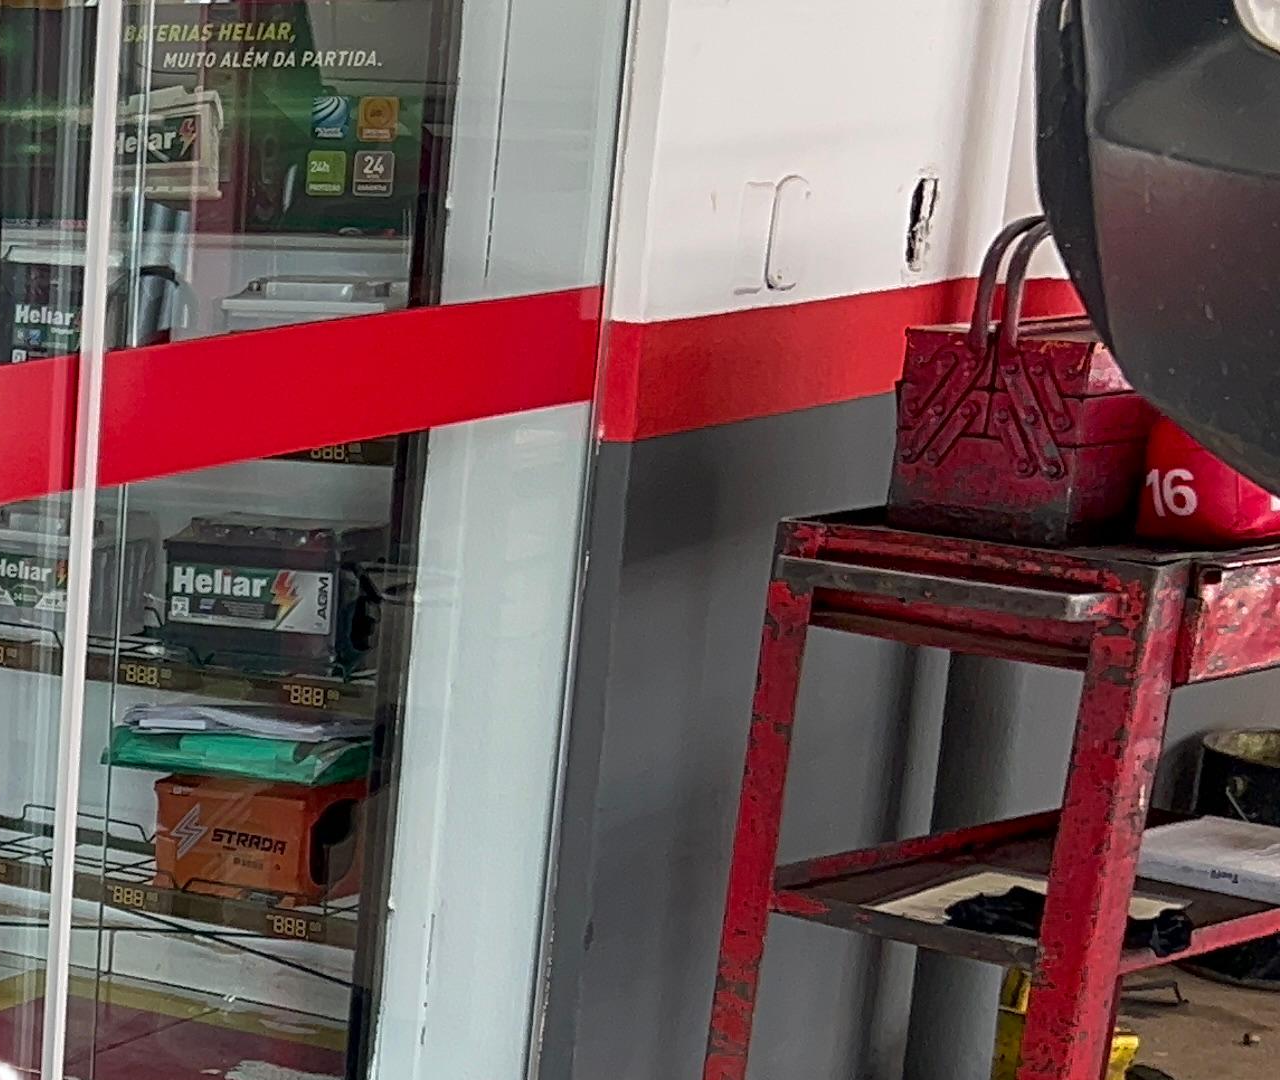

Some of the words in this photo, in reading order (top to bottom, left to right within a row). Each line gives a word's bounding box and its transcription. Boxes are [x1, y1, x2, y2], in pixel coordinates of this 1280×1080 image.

[124, 23, 215, 43] BATERIAS
[218, 22, 296, 44] HELIAR,
[163, 52, 216, 69] MUITO
[220, 46, 270, 69] ALÉM
[272, 51, 296, 69] DA
[301, 51, 382, 68] PARTIDA.
[363, 155, 385, 175] 24
[15, 304, 74, 326] Heliar
[1146, 468, 1198, 517] 16
[173, 566, 268, 598] Heliar
[316, 576, 329, 620] AGM
[211, 828, 288, 856] STRADA
